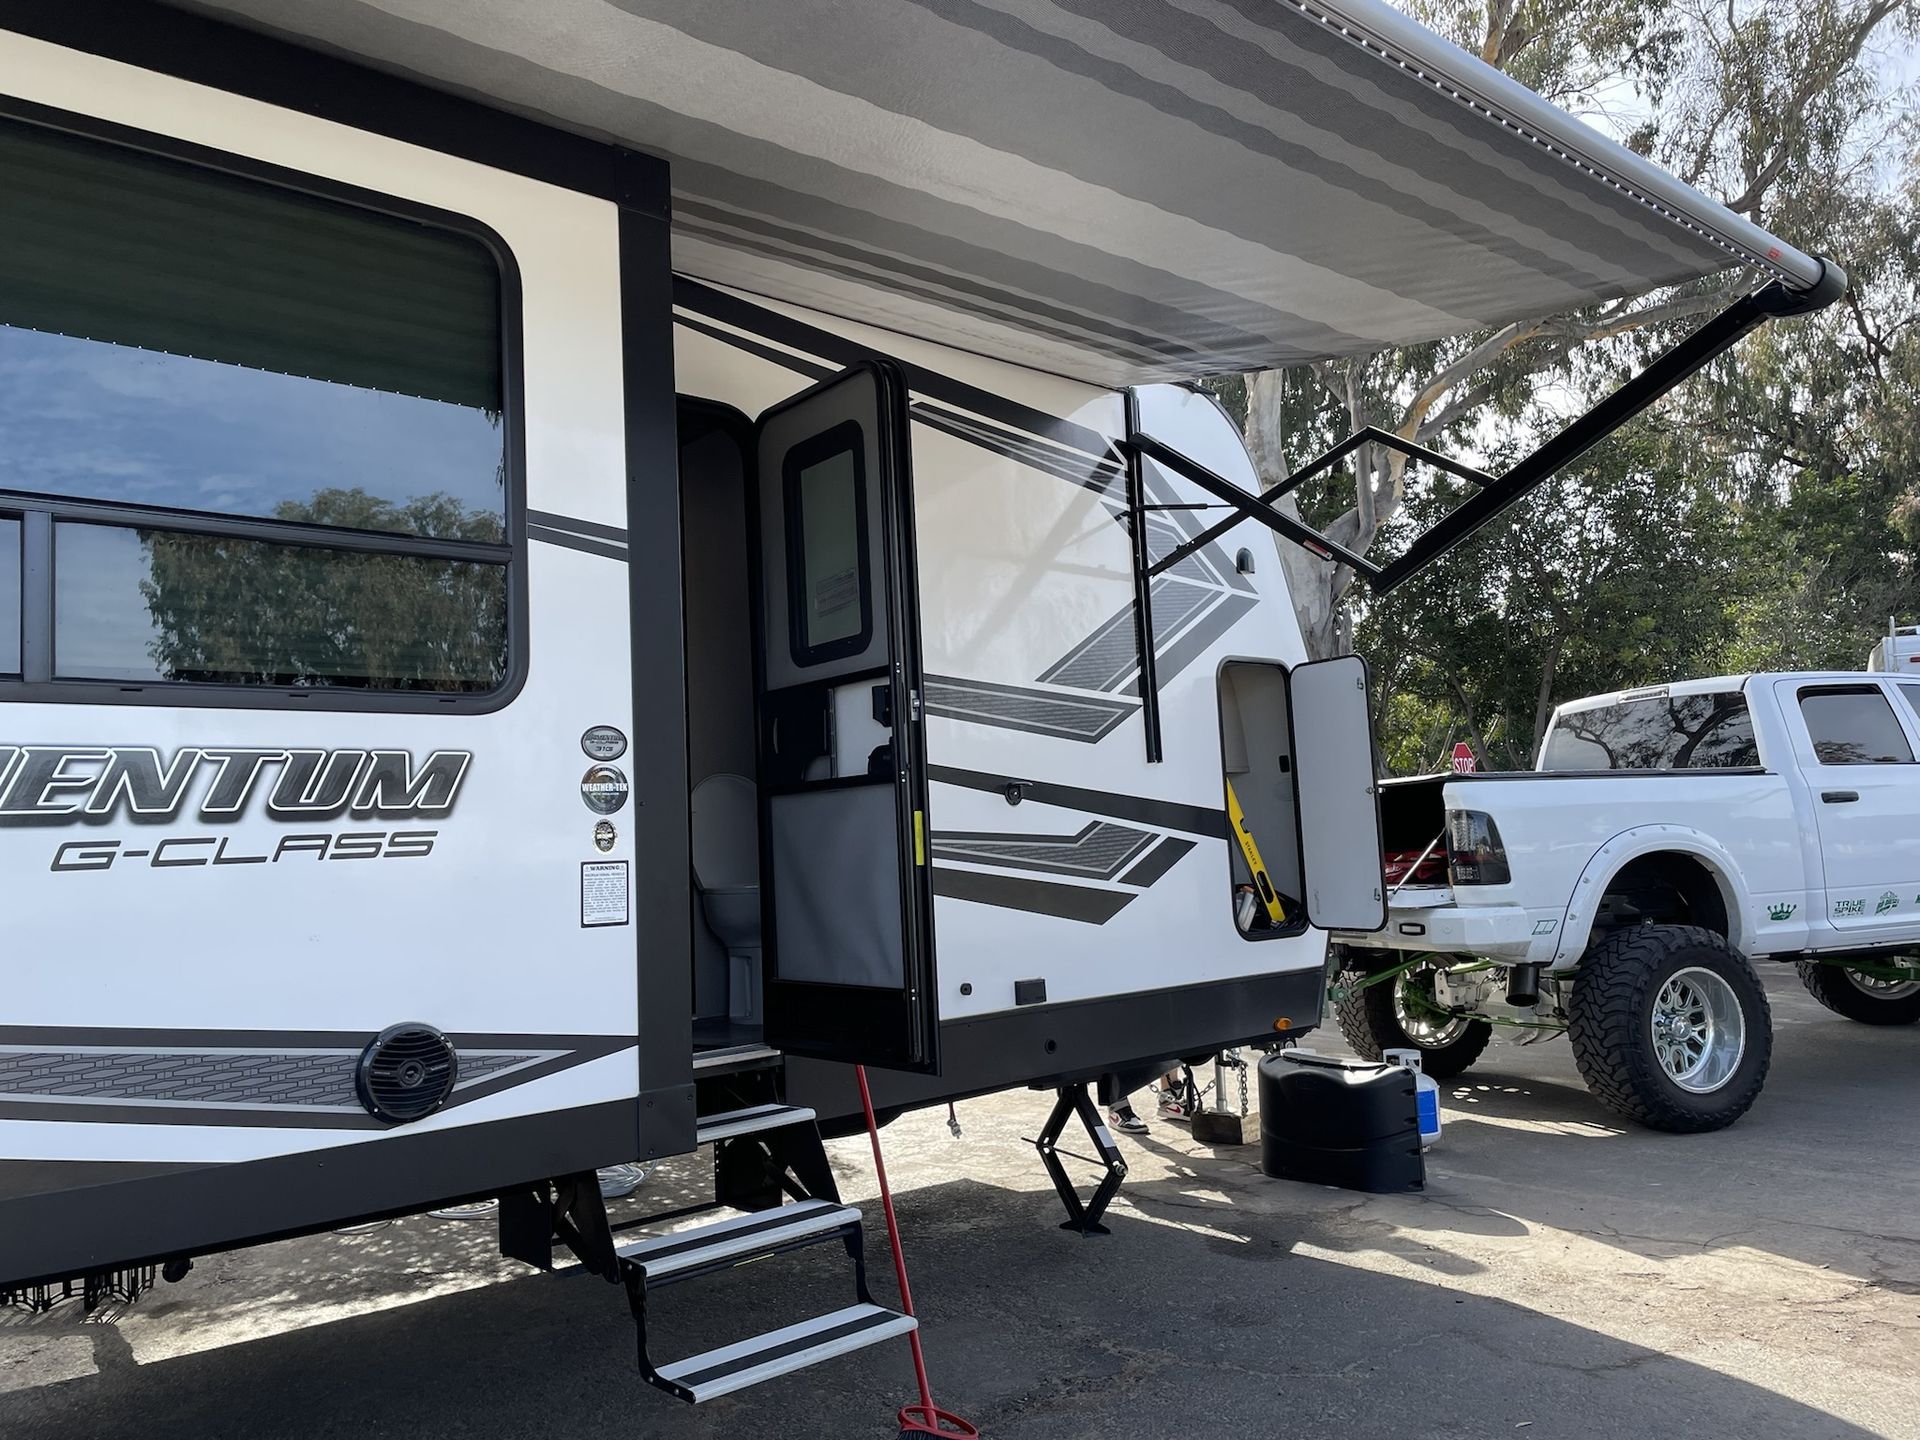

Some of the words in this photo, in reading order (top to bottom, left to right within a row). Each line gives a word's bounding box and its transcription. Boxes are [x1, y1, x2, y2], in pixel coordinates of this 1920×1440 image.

[1454, 757, 1473, 773] STOP
[0, 745, 472, 822] ENTUM
[581, 783, 628, 792] WEATHER-TEK
[50, 830, 439, 872] G-CLASS
[1834, 904, 1865, 914] SPIKE
[1835, 898, 1866, 907] TRUE
